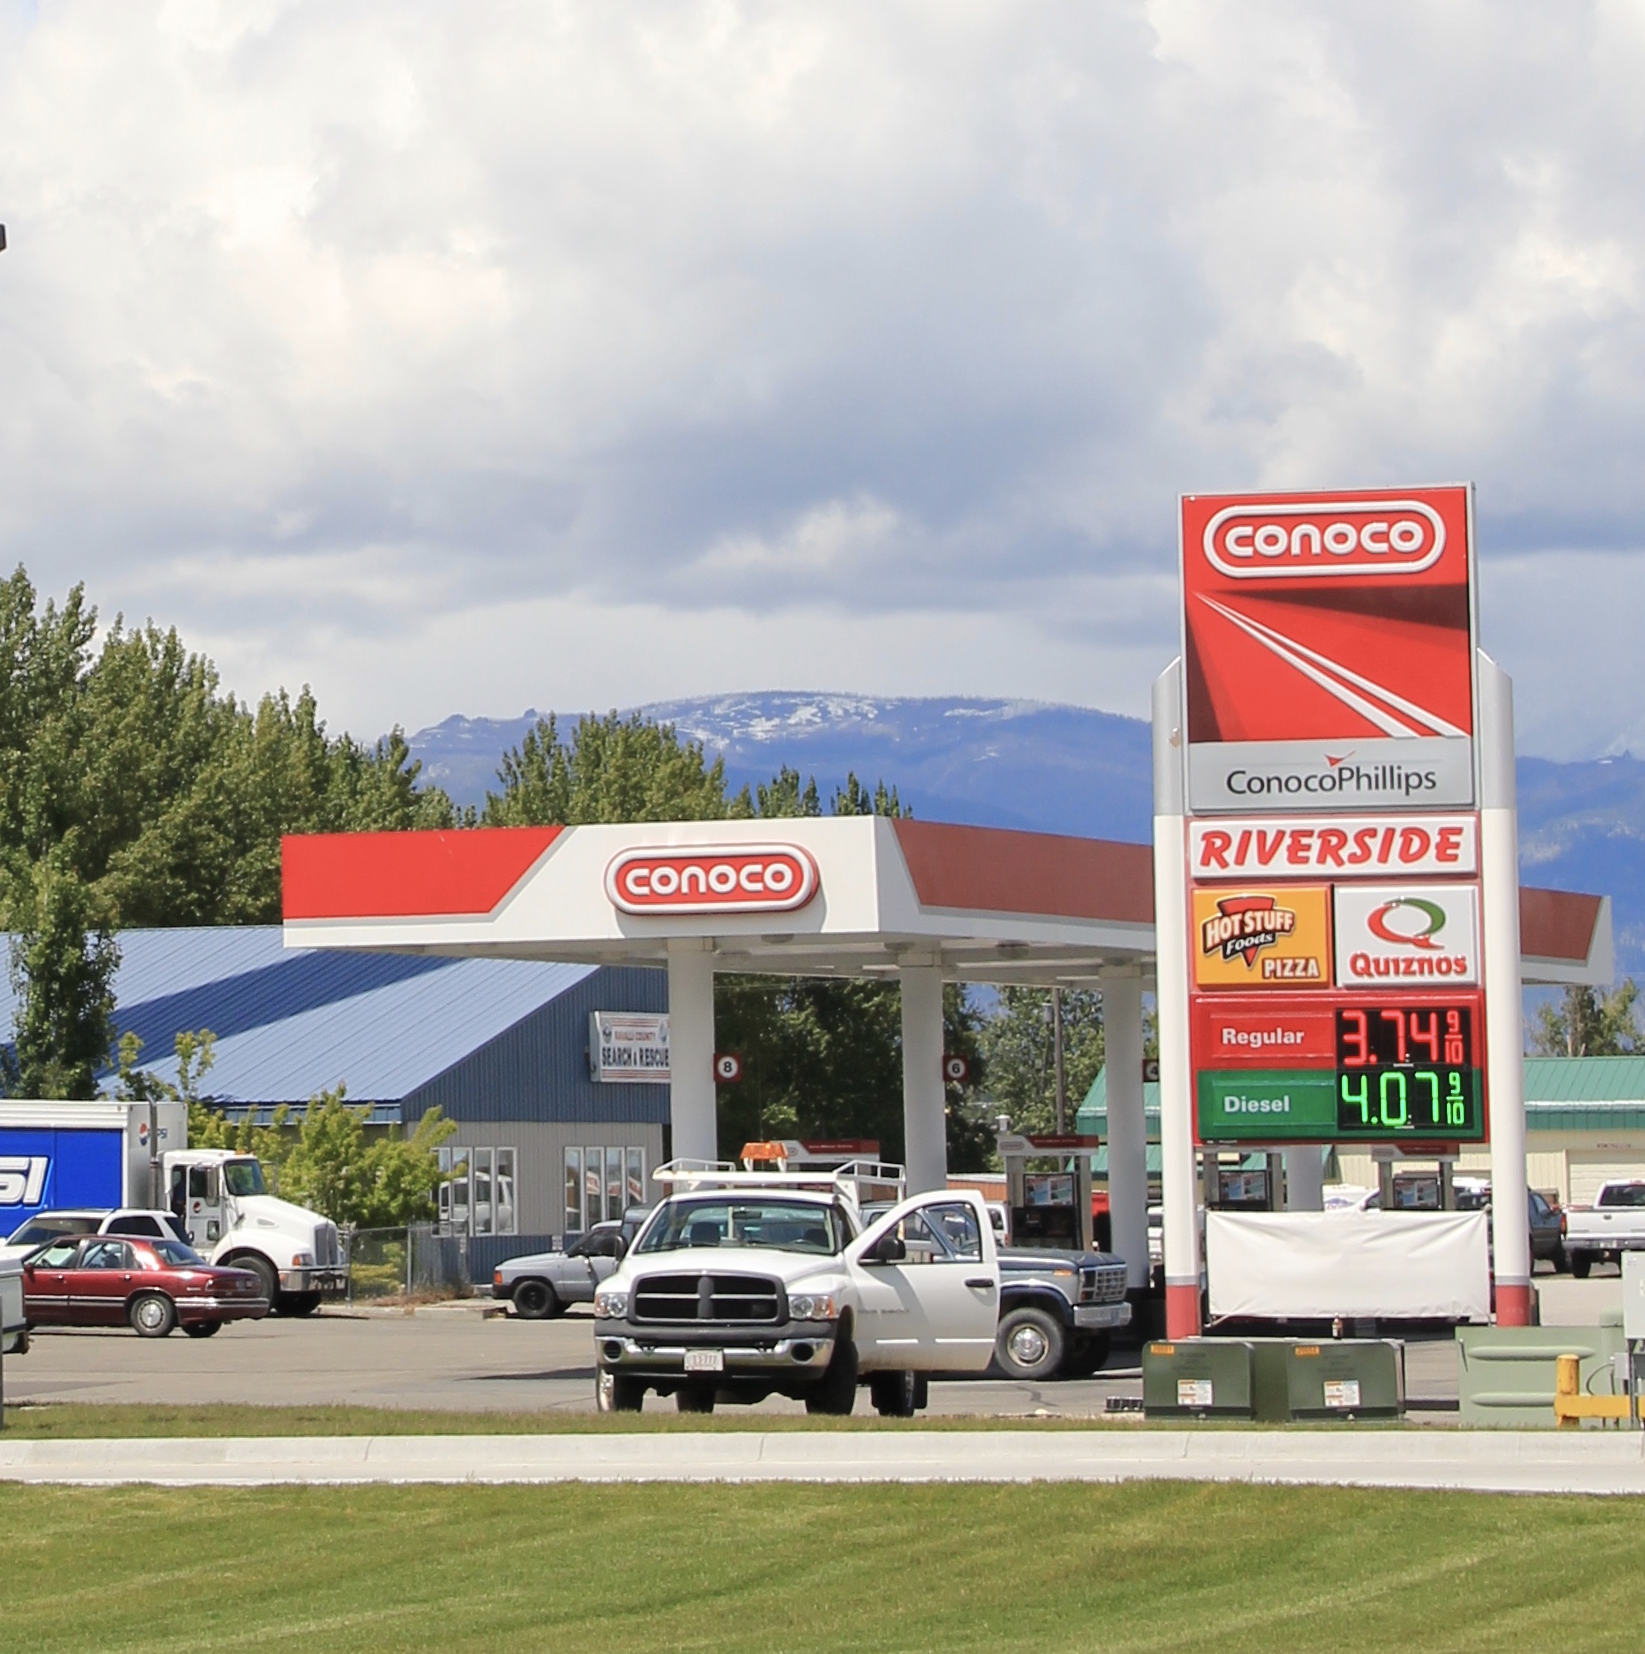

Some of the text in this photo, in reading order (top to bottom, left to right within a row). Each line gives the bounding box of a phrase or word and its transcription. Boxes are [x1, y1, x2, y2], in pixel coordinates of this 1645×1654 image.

[1226, 766, 1437, 796] ConocoPhillips
[1199, 826, 1464, 869] RIVERSIDE
[1206, 910, 1294, 947] HOT STUFF
[1226, 933, 1273, 956] Foods
[1264, 959, 1319, 979] PIZZA
[1222, 1027, 1304, 1048] Regular
[602, 1047, 632, 1066] SEARCH
[639, 1047, 669, 1067] RESCUE
[723, 1061, 732, 1073] 8
[951, 1063, 960, 1074] 6
[1224, 1095, 1289, 1113] Diesel
